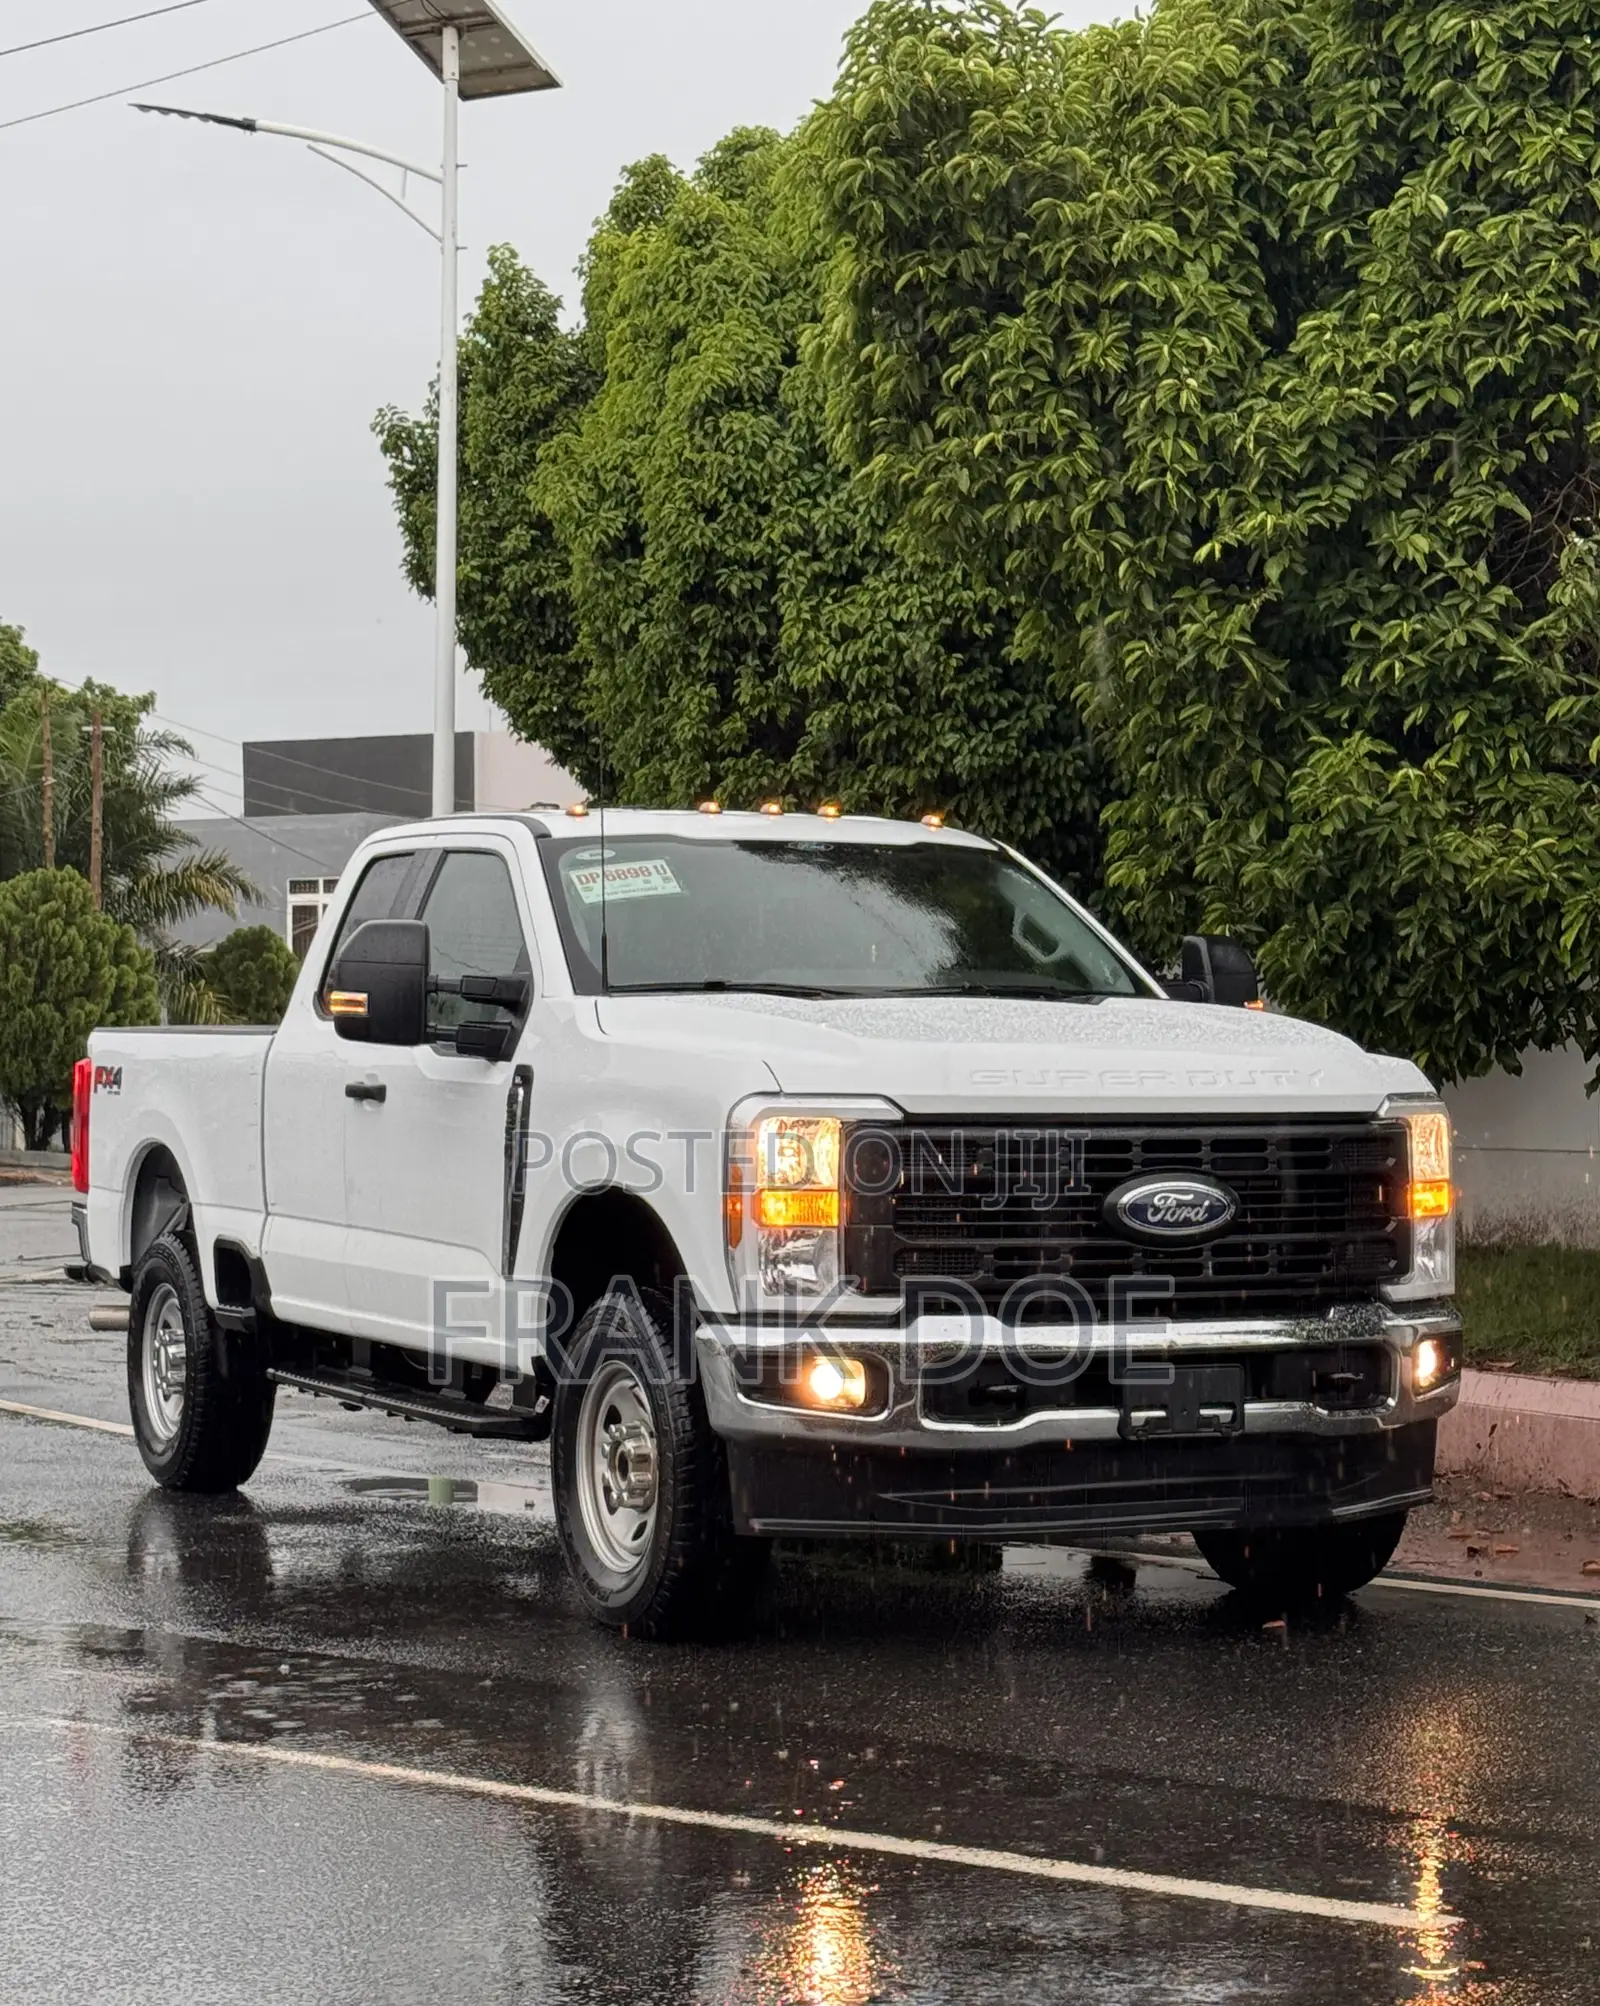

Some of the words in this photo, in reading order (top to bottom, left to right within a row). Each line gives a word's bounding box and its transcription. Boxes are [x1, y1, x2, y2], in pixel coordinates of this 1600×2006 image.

[576, 871, 600, 885] DP
[96, 1066, 122, 1093] FX4
[969, 1068, 1177, 1087] SUPER
[1186, 1068, 1325, 1087] DUTY
[1147, 1192, 1209, 1223] Ford
